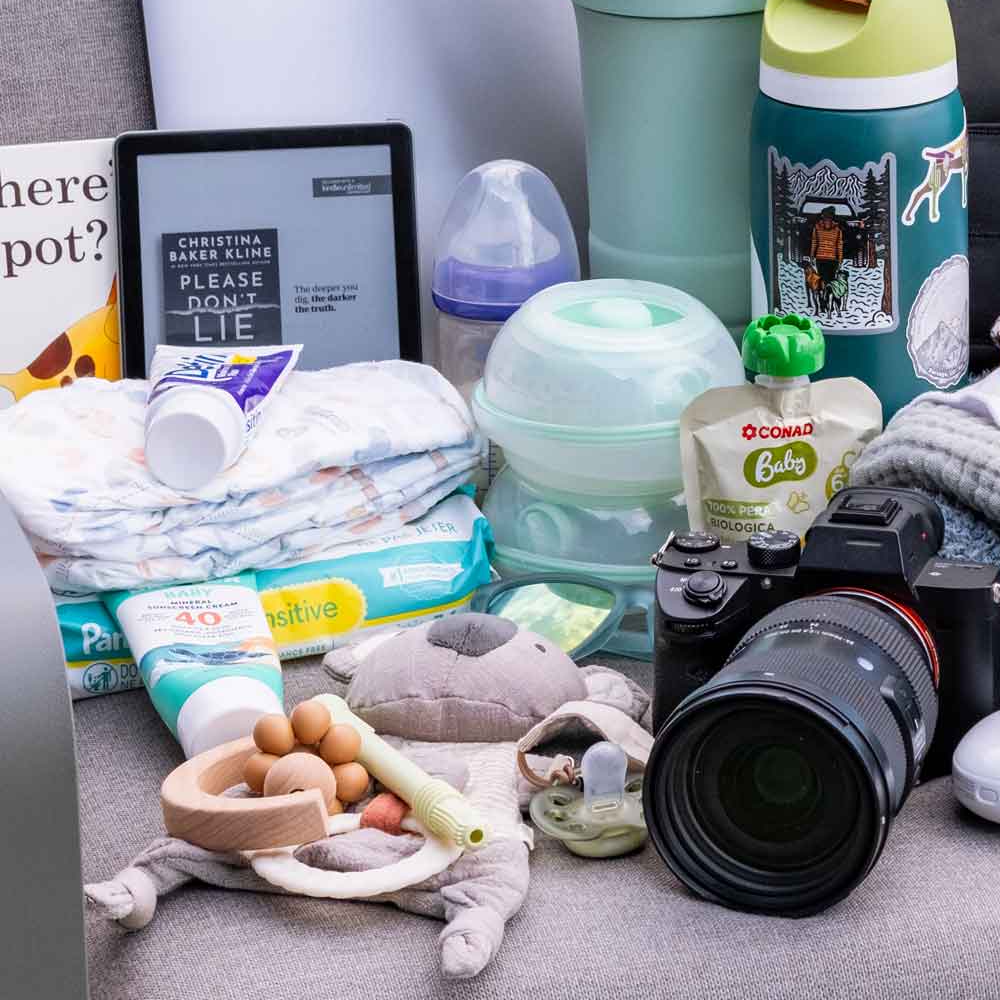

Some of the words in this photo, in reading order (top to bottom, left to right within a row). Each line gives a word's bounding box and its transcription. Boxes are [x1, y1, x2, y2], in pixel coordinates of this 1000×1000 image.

[178, 234, 262, 249] CHRISTINA
[169, 249, 219, 262] BAKER
[224, 246, 272, 260] KLINE
[180, 271, 263, 290] PLEASE
[188, 292, 257, 310] DON'T
[194, 313, 254, 342] LIE
[758, 423, 813, 439] CONAD
[755, 448, 806, 483] Baby
[709, 502, 736, 514] 100%
[711, 519, 776, 533] BIOLOGICA
[175, 611, 222, 626] 40
[120, 663, 138, 679] DO
